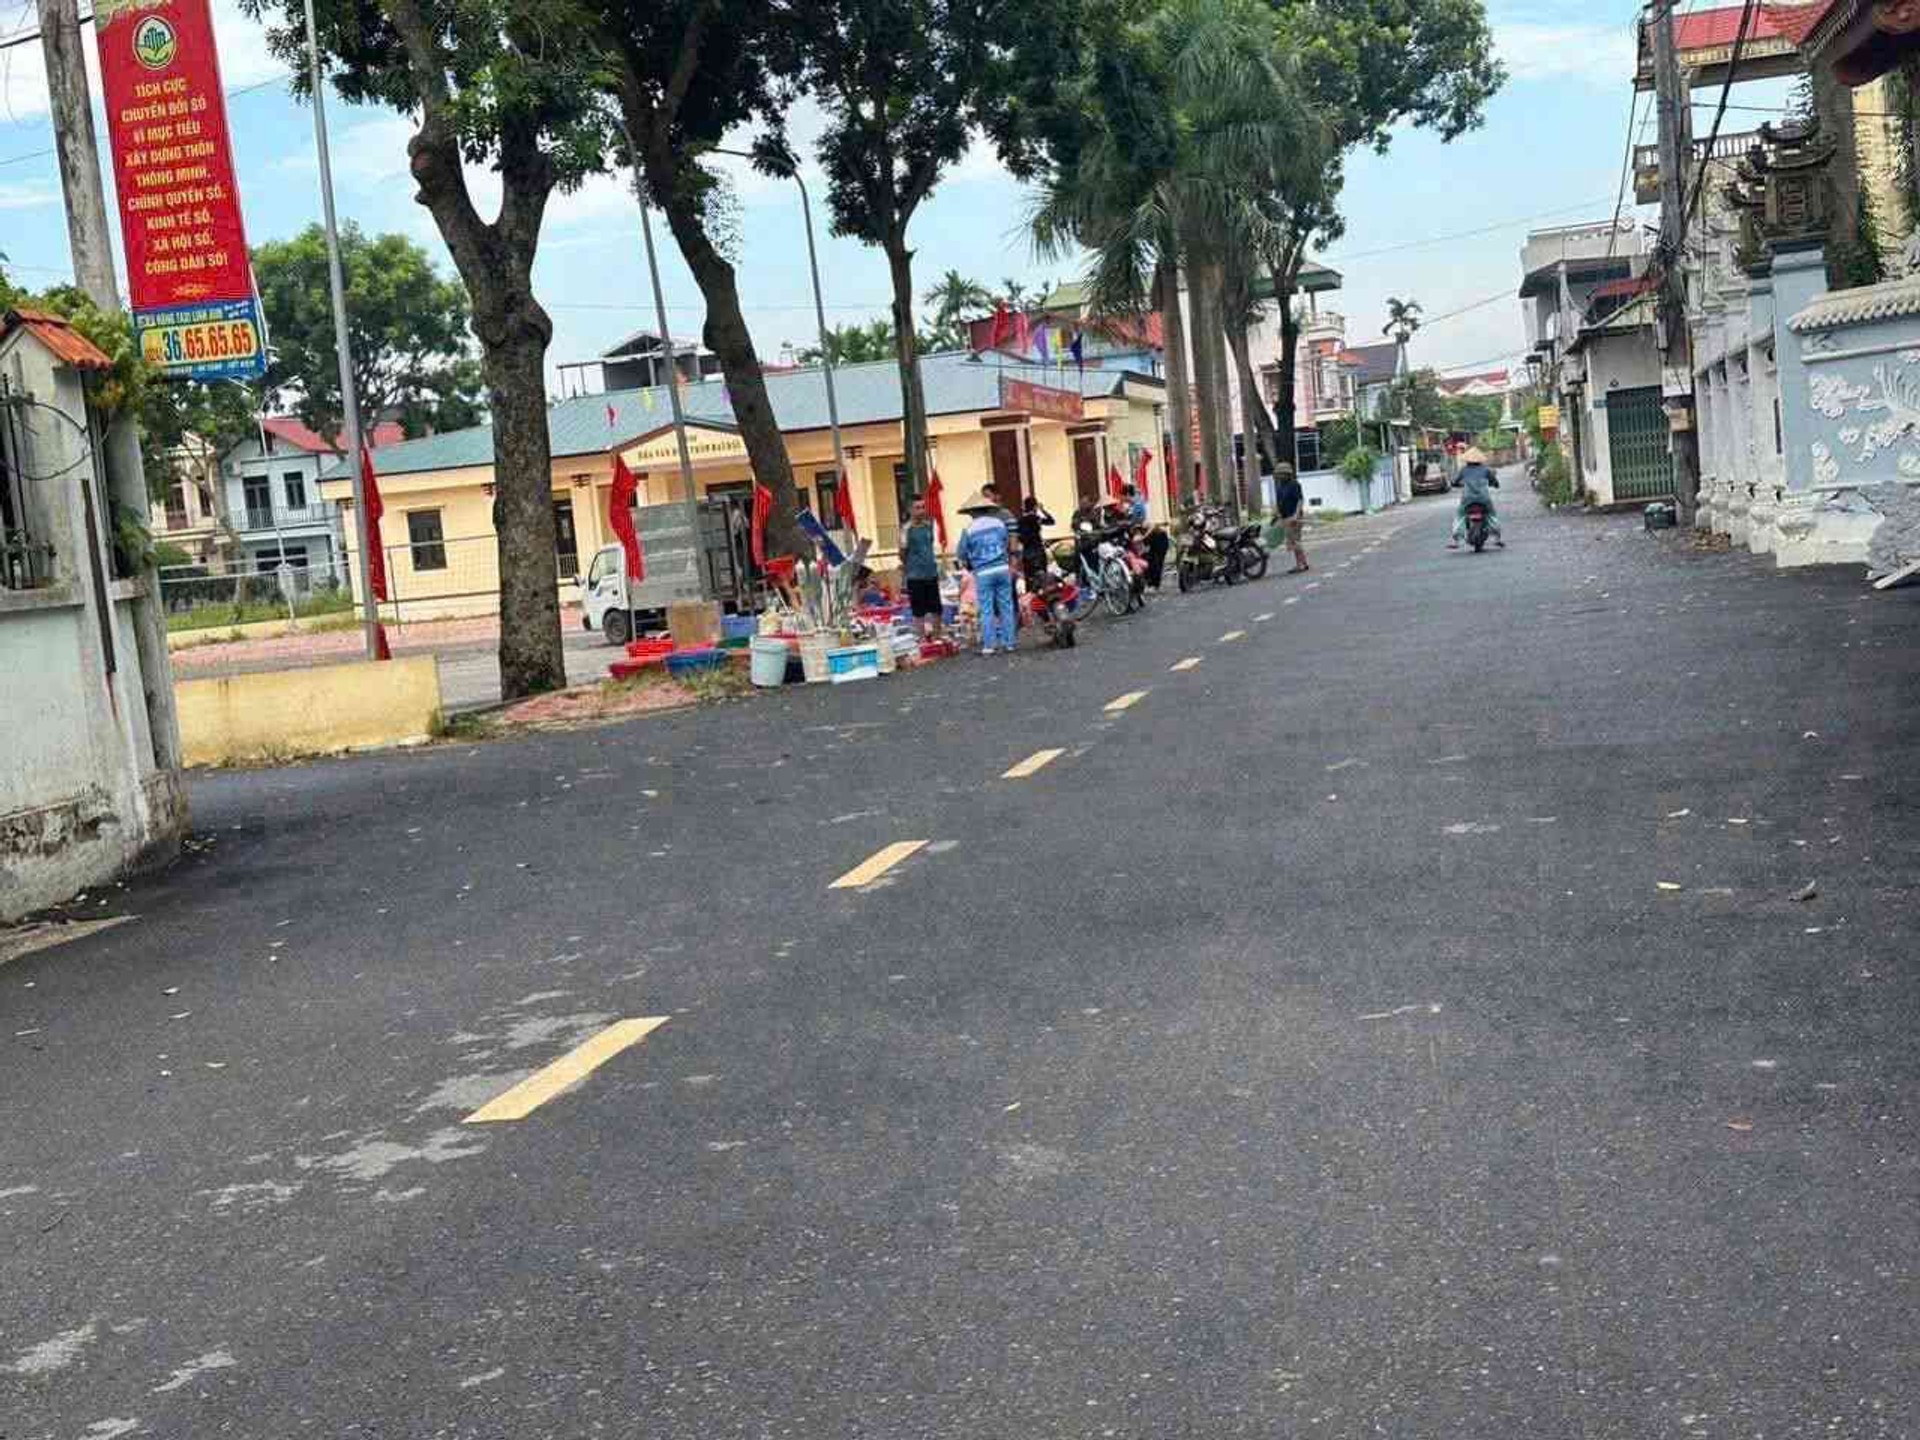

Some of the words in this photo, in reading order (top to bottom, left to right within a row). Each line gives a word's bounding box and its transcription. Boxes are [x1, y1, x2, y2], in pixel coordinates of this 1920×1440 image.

[135, 82, 160, 97] TÍCH
[163, 78, 187, 92] CỰC
[122, 101, 167, 122] CHUYỂN
[191, 93, 206, 111] SỐ
[147, 126, 173, 143] MỤC
[176, 119, 201, 135] TIÊU
[125, 150, 147, 167] XÂY
[150, 145, 181, 164] DỰNG
[182, 140, 215, 158] THÔN
[135, 169, 173, 187] THÔNG
[128, 193, 163, 211] CHÍNH
[167, 186, 203, 206] QUYỀN
[146, 215, 175, 230] KINH
[179, 209, 192, 225] TẾ
[171, 233, 192, 250] HỘI
[145, 258, 178, 275] CÔNG
[180, 253, 205, 270] DÂN
[162, 322, 252, 361] 36.65.65.65
